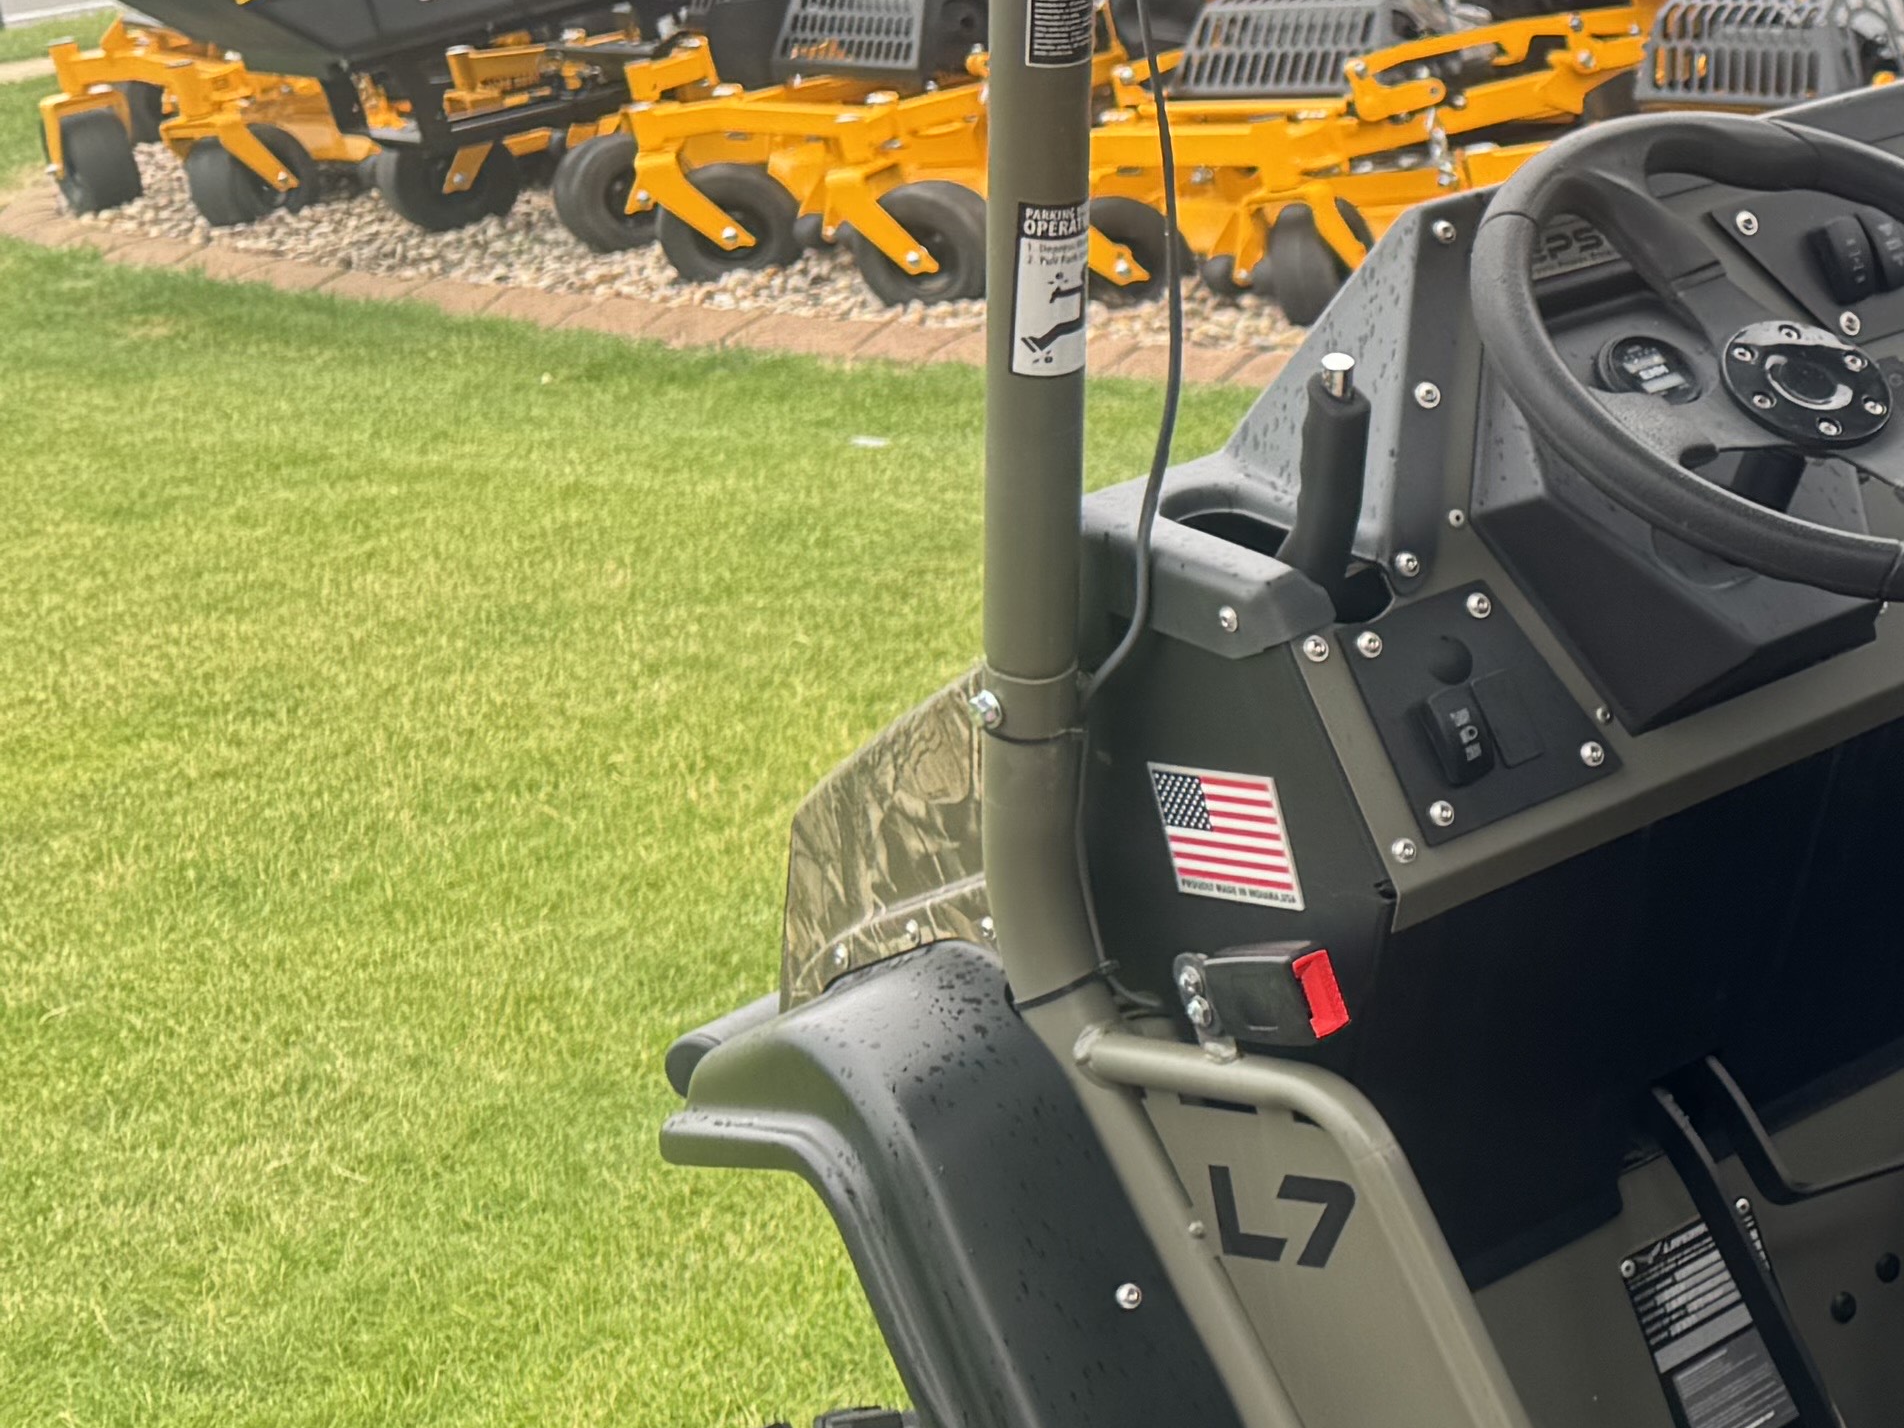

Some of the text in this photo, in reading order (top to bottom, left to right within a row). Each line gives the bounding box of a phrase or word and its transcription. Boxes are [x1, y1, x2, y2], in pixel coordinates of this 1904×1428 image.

[1025, 207, 1075, 220] PARKING
[1022, 218, 1083, 237] OPERAT
[1207, 1164, 1356, 1269] L7
